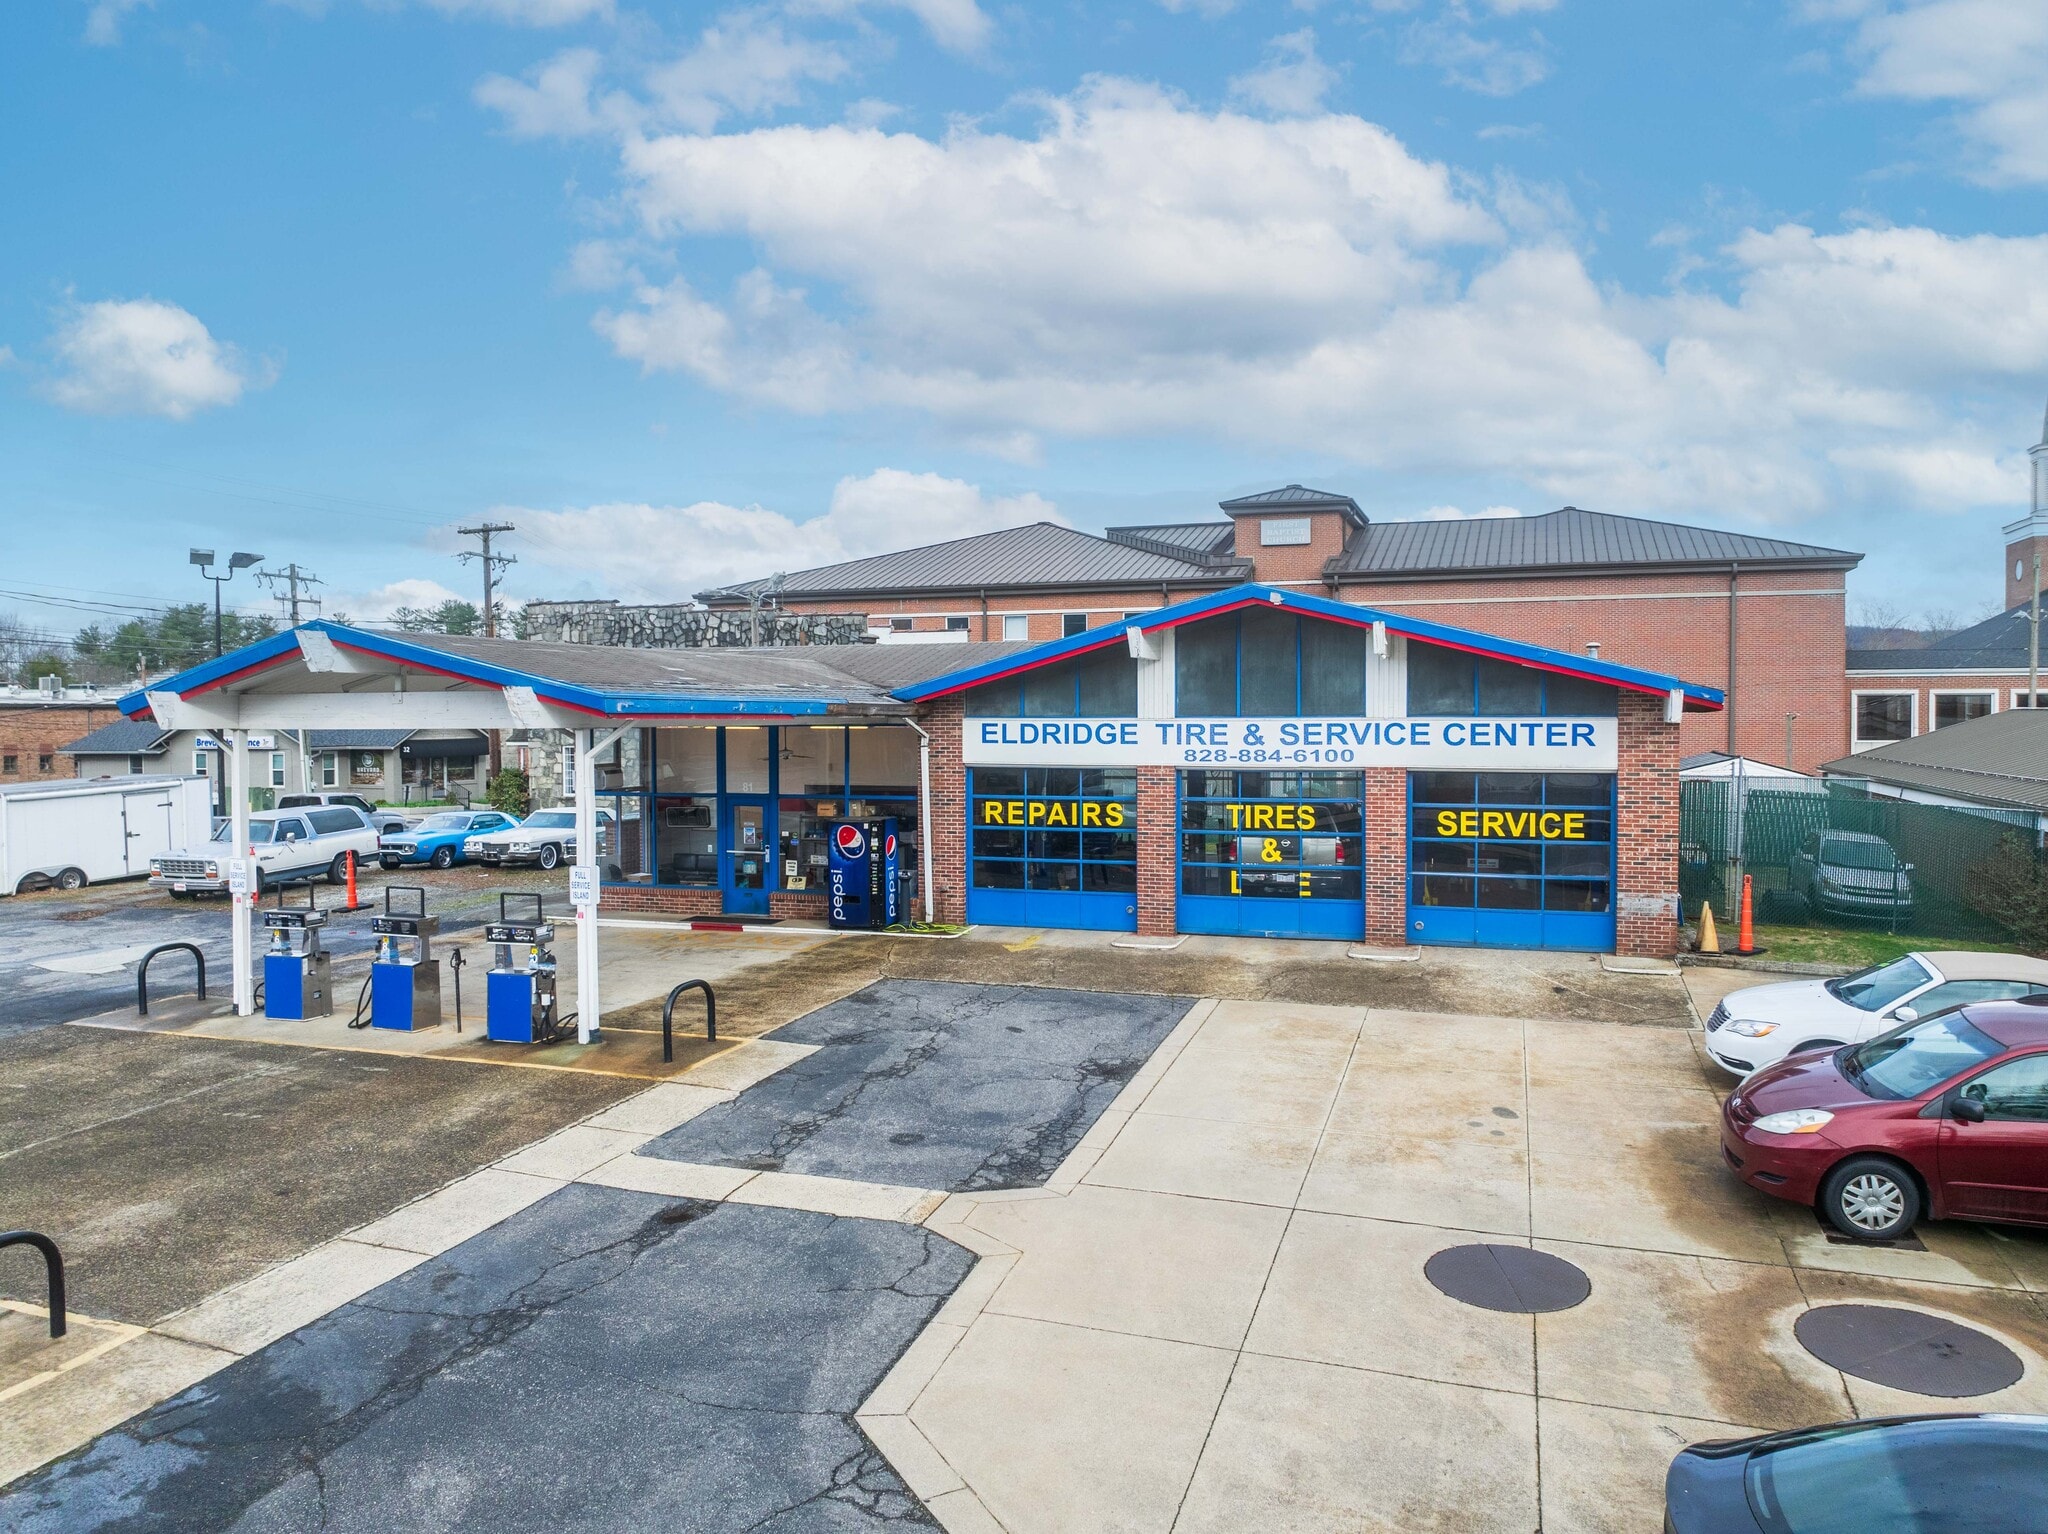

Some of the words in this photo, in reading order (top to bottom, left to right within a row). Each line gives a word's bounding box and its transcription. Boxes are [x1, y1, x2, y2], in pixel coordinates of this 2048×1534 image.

[982, 722, 1138, 745] ELDRIDGE
[1155, 723, 1228, 746] TIRE
[1243, 723, 1265, 746] &
[1280, 722, 1431, 746] SERVICE
[1442, 722, 1597, 747] CENTER
[1184, 749, 1355, 763] 828-884-6100
[742, 782, 754, 792] 81
[985, 801, 1124, 827] REPAIRS
[1226, 804, 1316, 830] TIRES
[1437, 810, 1585, 839] SERVICE
[1261, 838, 1283, 862] &
[230, 871, 246, 879] SERVICE
[571, 880, 591, 890] SERVICE
[575, 871, 586, 879] FULL
[1230, 870, 1311, 897] LE
[573, 891, 589, 899] ISLAND
[830, 869, 847, 920] pepsi
[887, 866, 896, 918] pepsi
